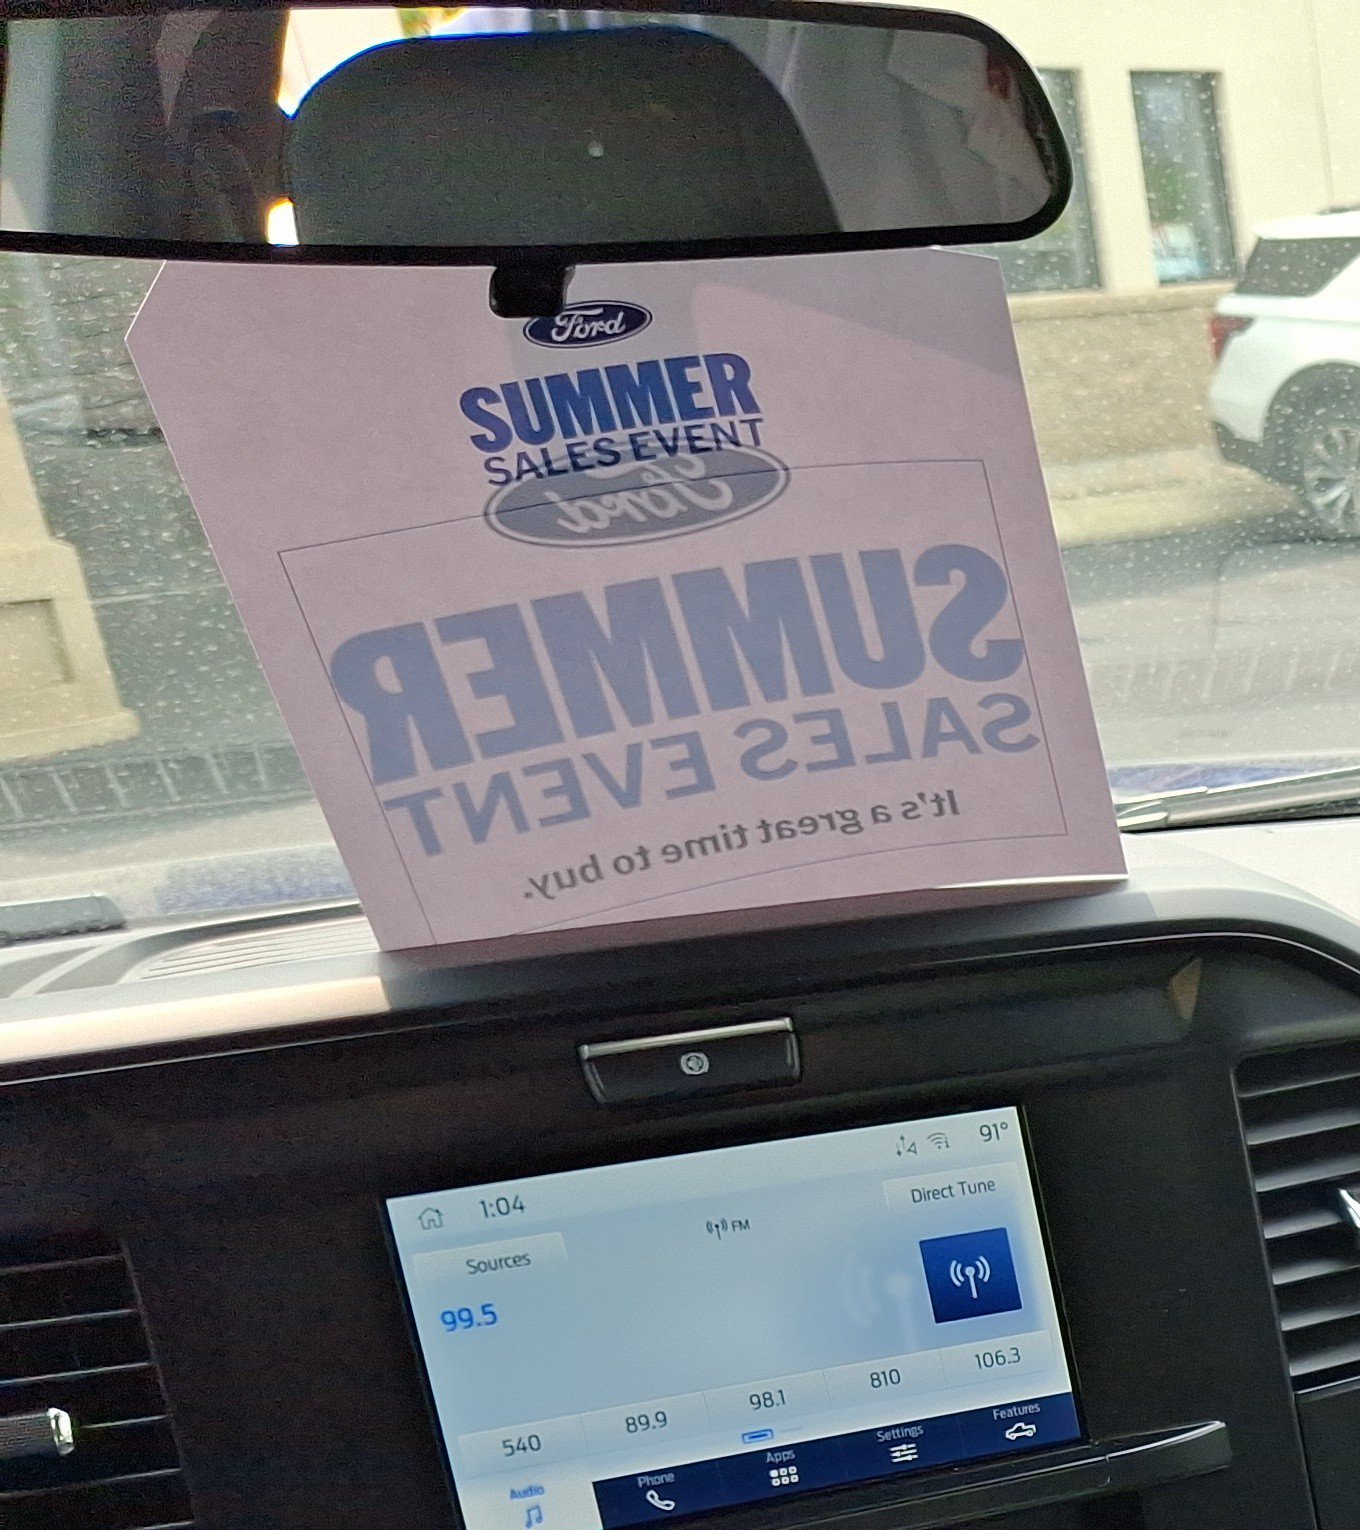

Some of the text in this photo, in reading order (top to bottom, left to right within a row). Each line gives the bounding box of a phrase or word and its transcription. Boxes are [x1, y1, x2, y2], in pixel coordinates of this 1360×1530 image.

[552, 307, 626, 341] Ford
[460, 353, 762, 453] SUMMER
[484, 418, 763, 487] SALES EVENT
[910, 1177, 996, 1204] Direct Tune
[479, 1194, 526, 1219] 1:04
[731, 1218, 750, 1232] FM
[465, 1250, 531, 1276] Sources
[439, 1303, 498, 1332] 99.5
[973, 1347, 1022, 1371] 106.3
[870, 1368, 901, 1389] 810
[749, 1388, 786, 1413] 98.1
[992, 1400, 1041, 1420] Features
[625, 1409, 668, 1434] 89.9
[876, 1422, 925, 1444] Settings
[502, 1433, 542, 1458] 540
[765, 1448, 796, 1468] Apps
[509, 1482, 545, 1501] Audio
[637, 1469, 675, 1489] Phone
